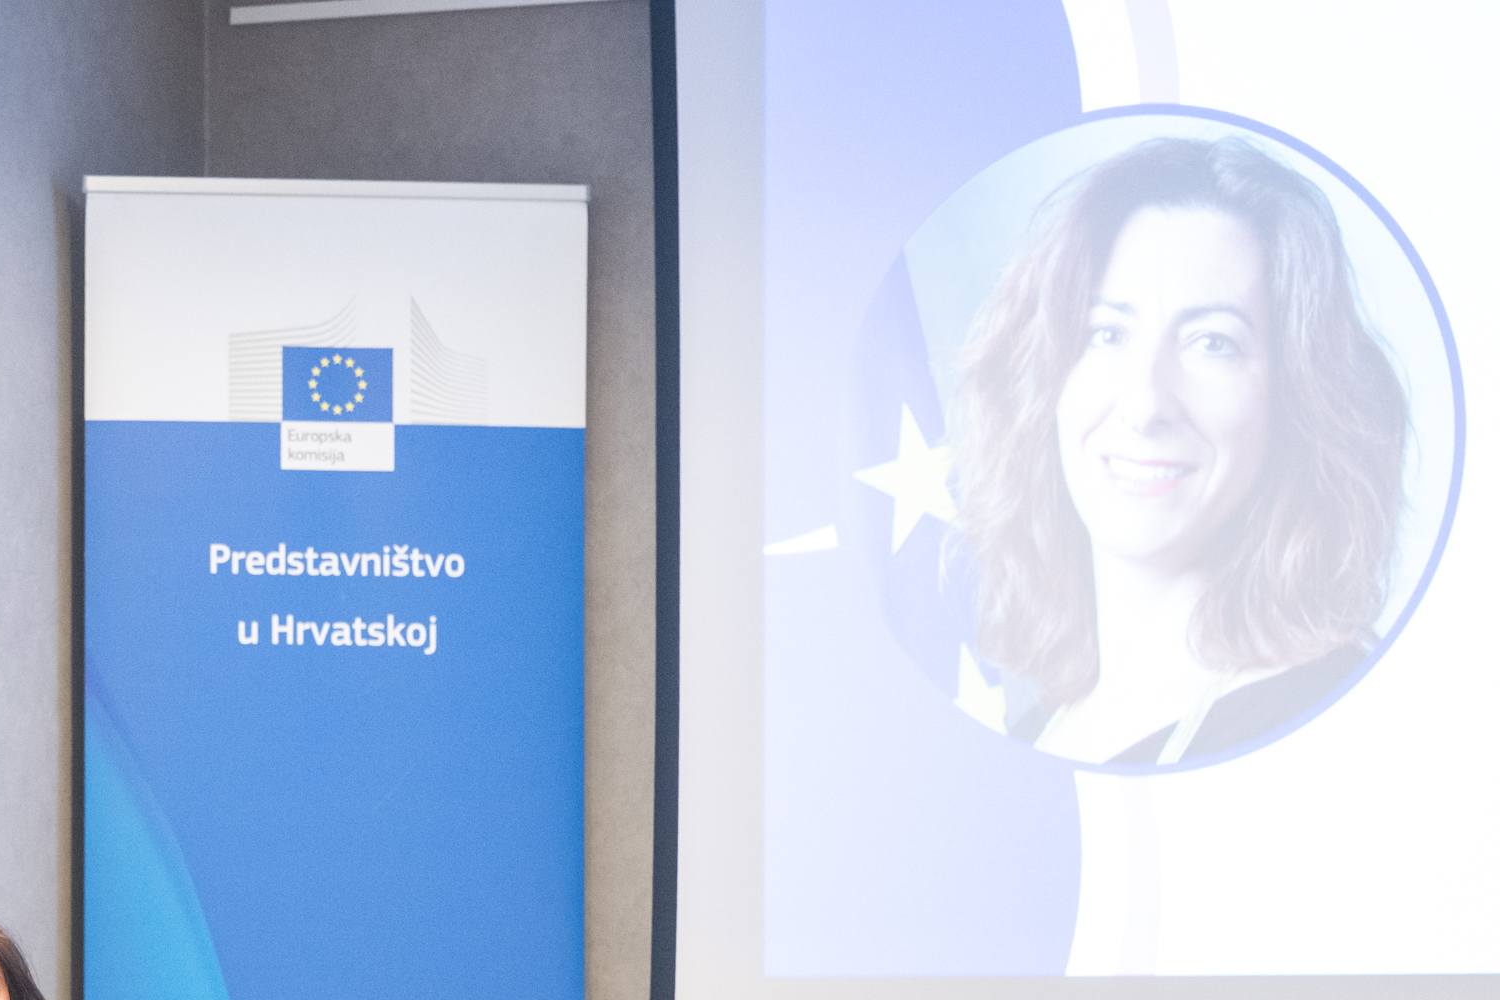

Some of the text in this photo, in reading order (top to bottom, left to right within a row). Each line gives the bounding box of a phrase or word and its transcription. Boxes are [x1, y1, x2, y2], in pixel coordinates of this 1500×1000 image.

[286, 427, 352, 444] Europska
[286, 447, 345, 466] komisija
[209, 542, 466, 578] Predstavništvo
[237, 613, 438, 656] u Hrvatskoj
